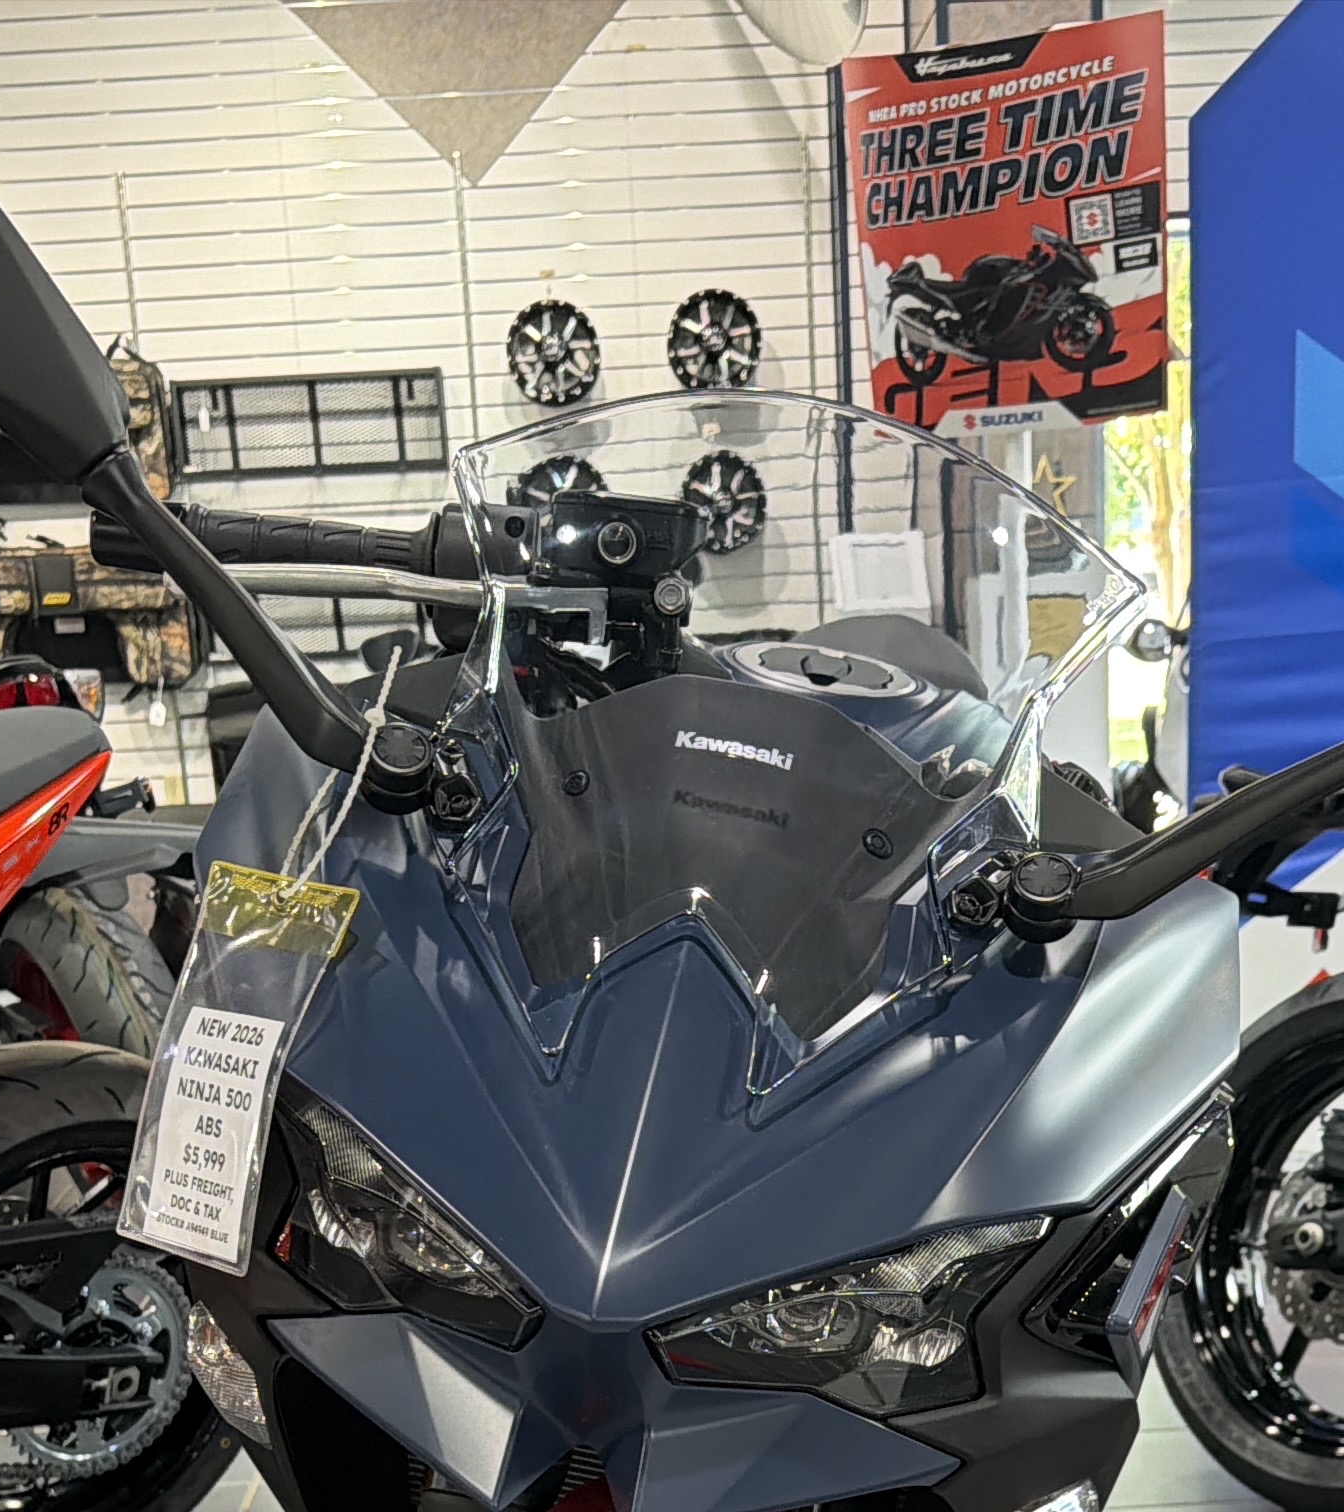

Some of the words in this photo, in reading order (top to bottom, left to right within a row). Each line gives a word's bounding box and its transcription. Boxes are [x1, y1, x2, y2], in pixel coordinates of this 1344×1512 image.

[899, 100, 927, 118] PRO
[929, 87, 983, 114] STOCK
[987, 55, 1115, 100] MOTORCYCLE
[860, 110, 991, 179] THREE
[1000, 68, 1149, 152] TIME
[866, 129, 1132, 230] CHAMPION
[979, 411, 1044, 428] SUZUKI
[674, 730, 794, 771] Kawasaki
[196, 1016, 232, 1040] NEW
[231, 1023, 265, 1047] 2026
[184, 1045, 259, 1080] KAWASAKI
[176, 1076, 221, 1106] NINJA
[225, 1087, 253, 1112] 500
[194, 1114, 223, 1138] ABS
[182, 1142, 226, 1172] $5,999
[163, 1168, 189, 1188] PLUS
[190, 1175, 234, 1205] FREIGHT,
[170, 1193, 192, 1213] DOC
[193, 1200, 201, 1216] &
[203, 1203, 222, 1222] TAX
[209, 1228, 230, 1244] BLUE
